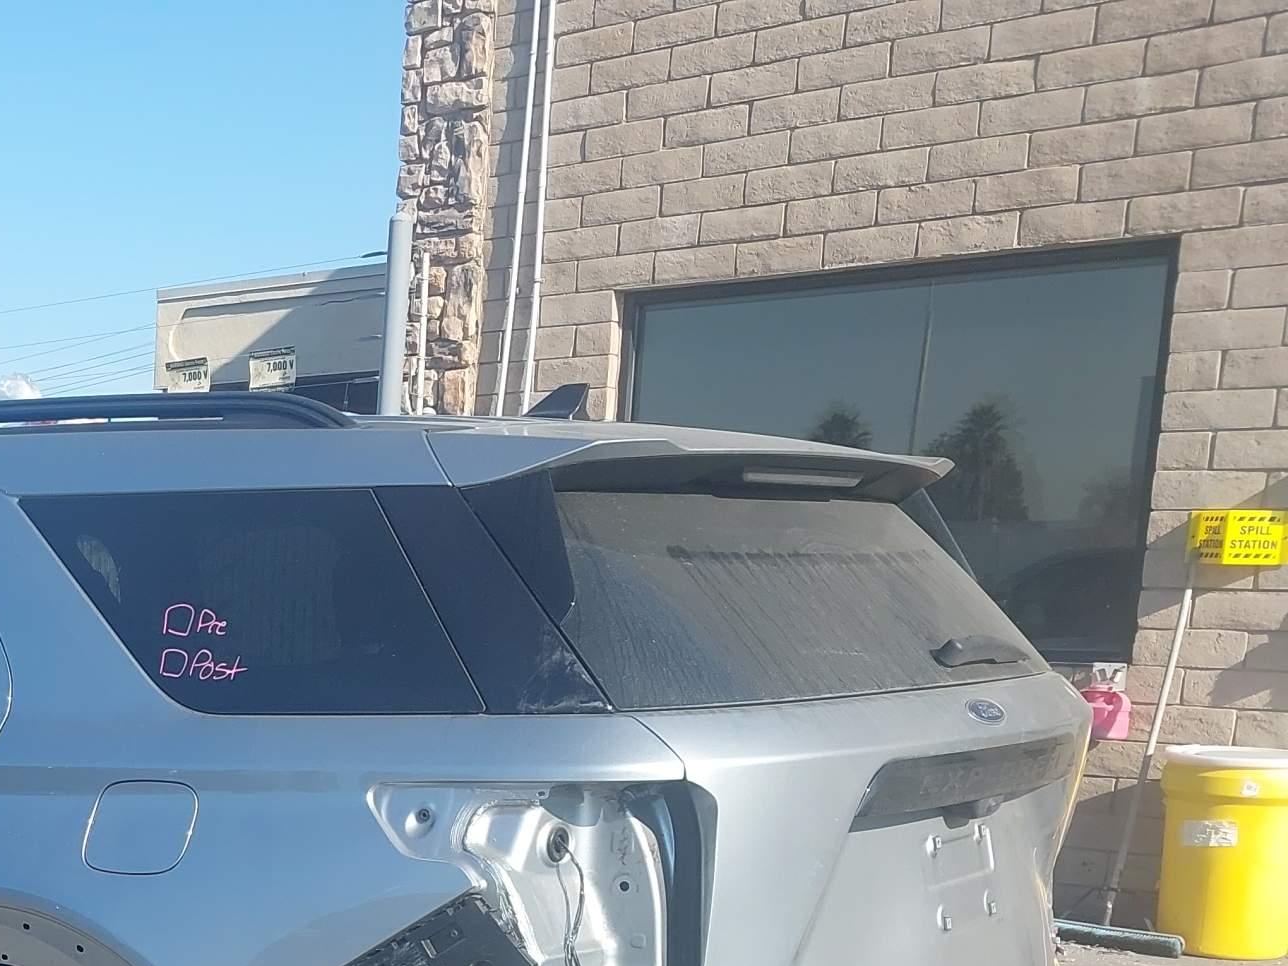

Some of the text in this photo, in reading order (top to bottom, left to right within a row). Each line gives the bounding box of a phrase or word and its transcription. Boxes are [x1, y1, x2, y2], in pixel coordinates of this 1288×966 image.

[266, 360, 288, 373] 7,000
[182, 371, 202, 383] 7,000
[1240, 526, 1272, 536] SPILL
[1230, 540, 1278, 549] STATION
